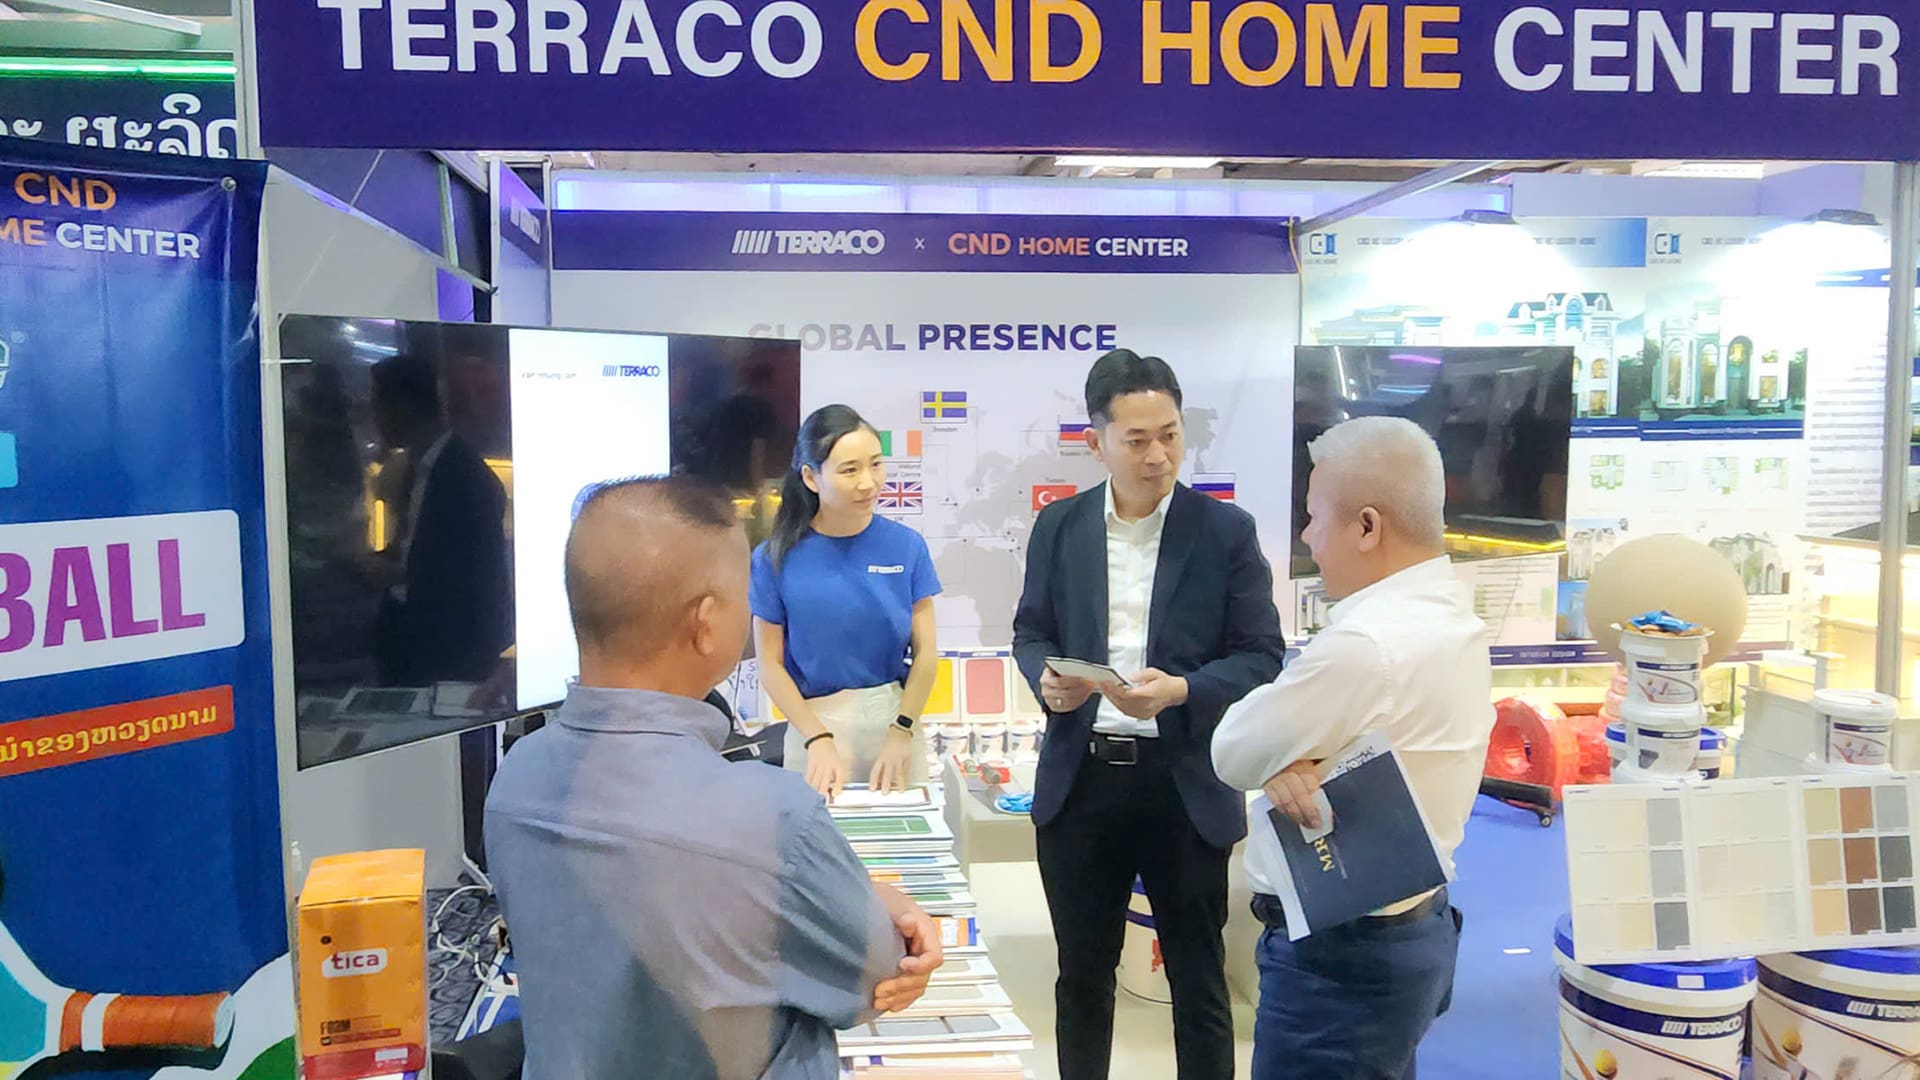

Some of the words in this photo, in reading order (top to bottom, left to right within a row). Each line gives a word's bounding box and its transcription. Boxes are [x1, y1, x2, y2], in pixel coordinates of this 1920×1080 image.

[317, 0, 824, 79] TERRACO
[854, 0, 1102, 82] CND
[1142, 0, 1462, 89] HOME
[1494, 6, 1900, 96] CENTER
[14, 172, 117, 211] CND
[55, 222, 200, 259] CENTER
[775, 230, 886, 255] TERRACO
[948, 232, 1012, 256] CND
[1018, 237, 1091, 257] HOME
[1095, 237, 1189, 257] CENTER
[918, 323, 1117, 351] PRESENCE
[332, 952, 379, 970] tica
